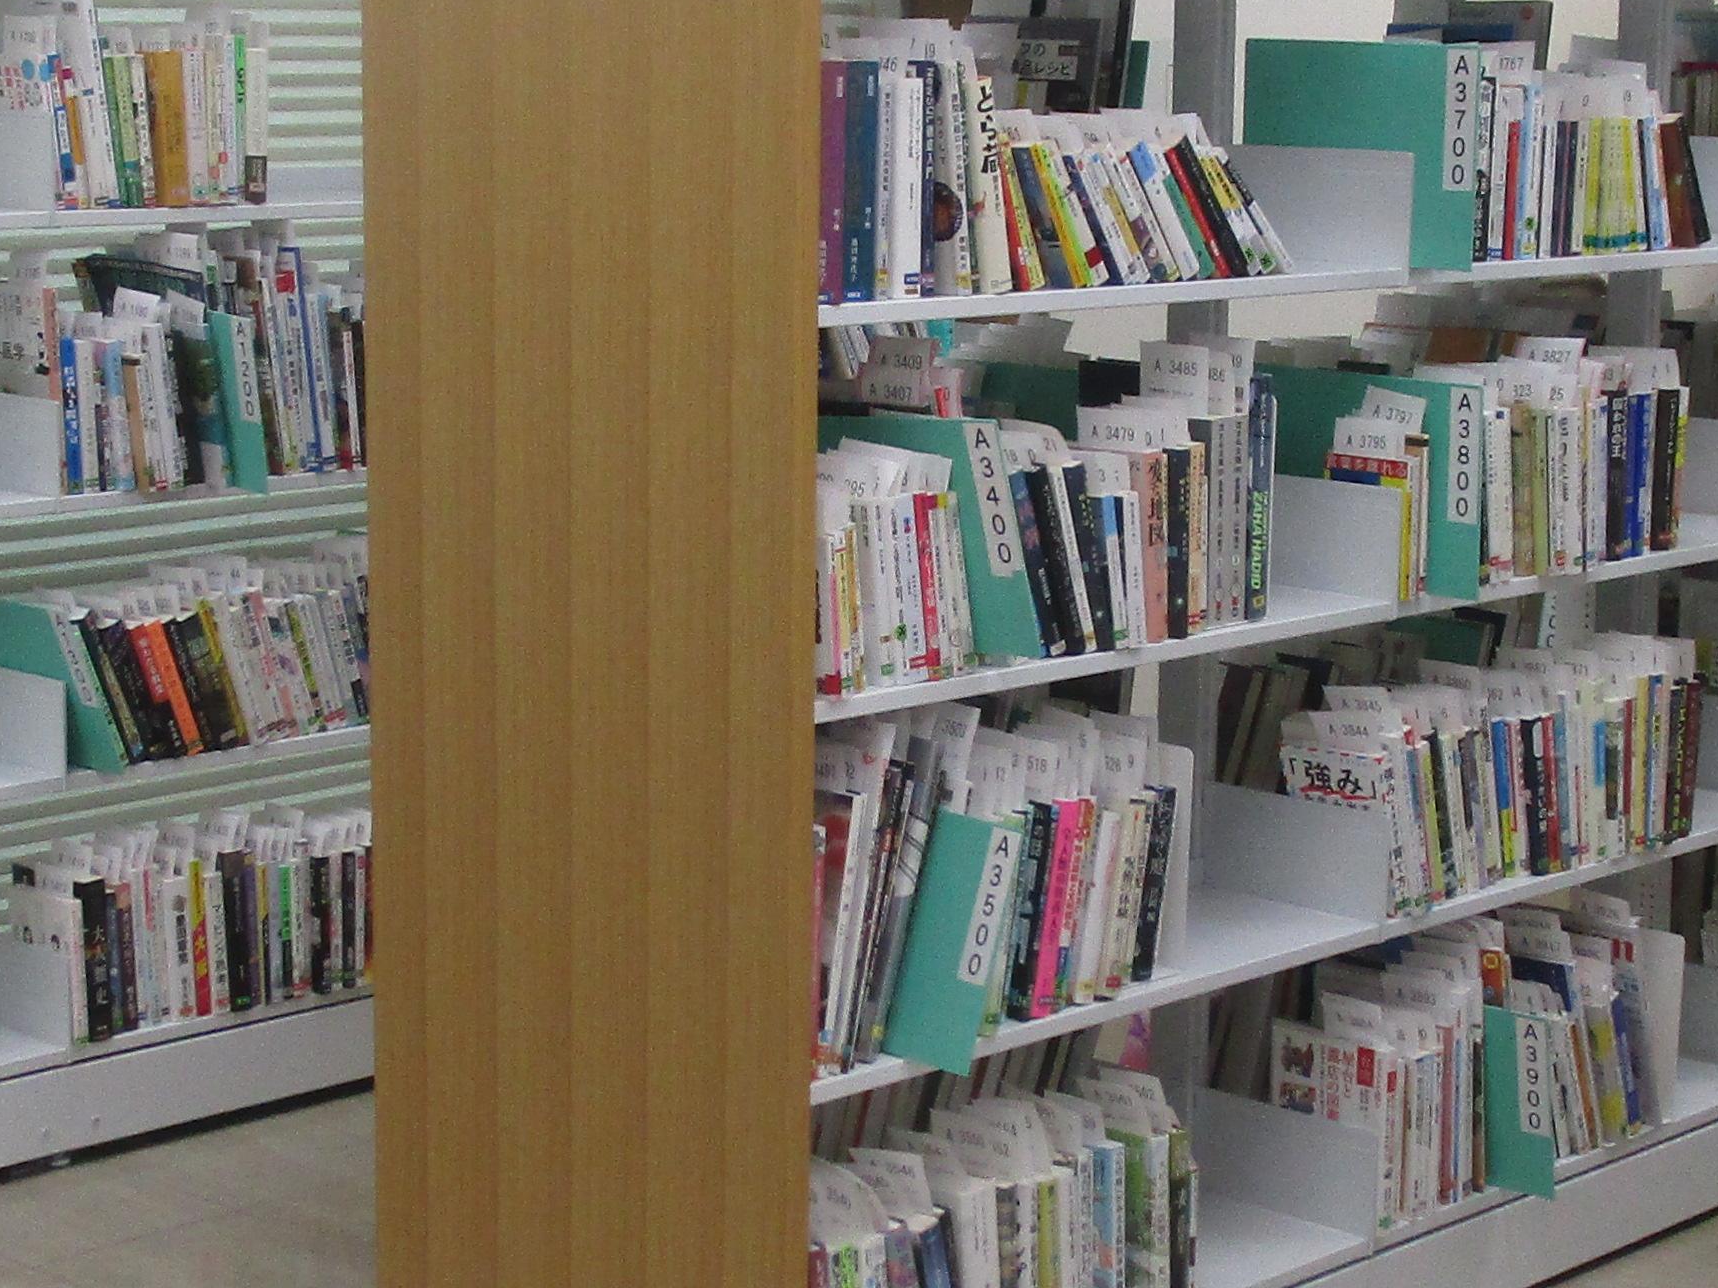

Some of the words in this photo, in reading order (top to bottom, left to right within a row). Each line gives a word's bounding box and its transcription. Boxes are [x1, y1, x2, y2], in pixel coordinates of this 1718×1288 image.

[1451, 54, 1470, 185] A3700
[235, 320, 256, 419] A1200
[893, 353, 923, 370] 3409
[1169, 359, 1199, 376] 3485
[1541, 350, 1572, 363] 3827
[883, 383, 913, 401] 3407
[1105, 424, 1135, 443] 3479
[1385, 407, 1413, 425] 3797
[1359, 435, 1386, 449] 3795
[1455, 392, 1472, 518] A3800
[974, 427, 1012, 564] A3400
[1252, 490, 1269, 541] ZAHA
[1249, 541, 1265, 591] HADID
[1288, 757, 1377, 800] 「強み」
[967, 834, 1010, 976] A3500
[1523, 1023, 1541, 1130] A3900
